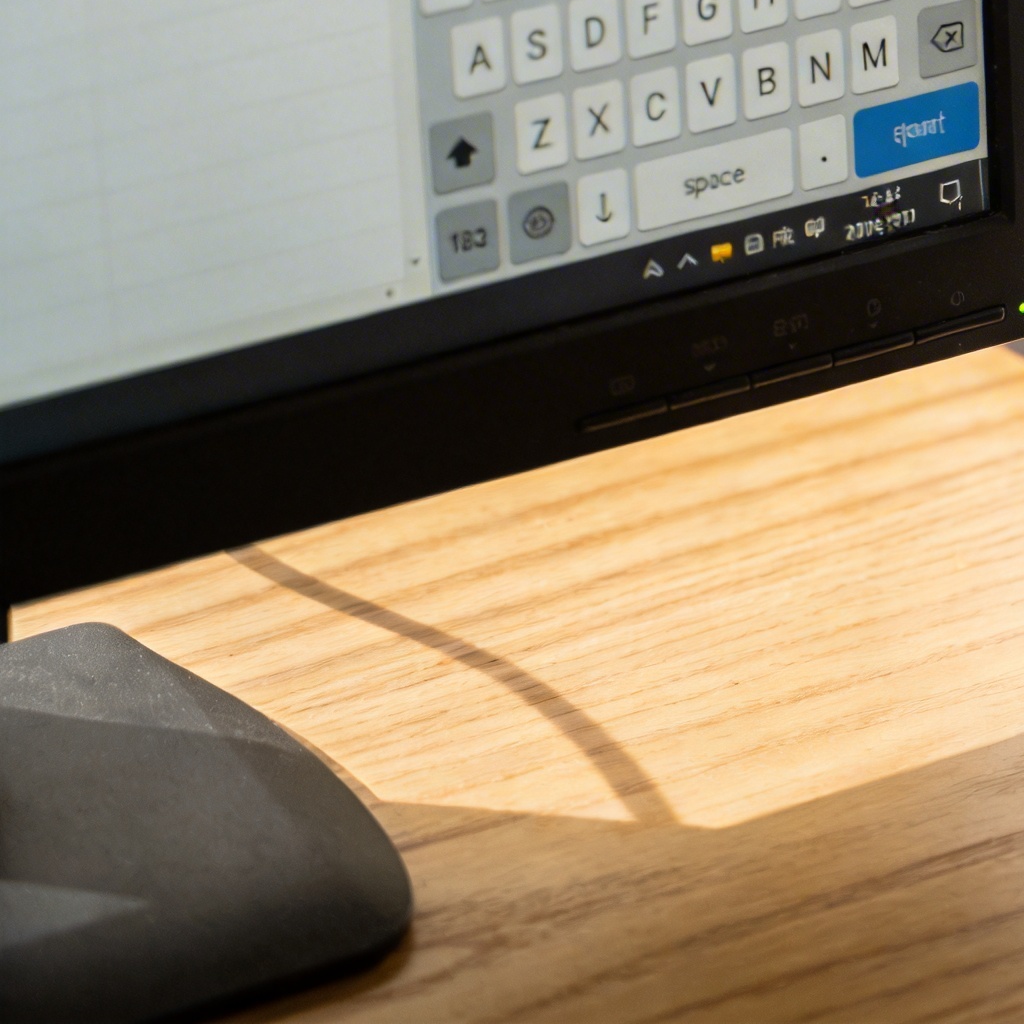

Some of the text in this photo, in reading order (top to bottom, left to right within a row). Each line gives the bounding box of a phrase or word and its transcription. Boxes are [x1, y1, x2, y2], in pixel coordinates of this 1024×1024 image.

[469, 44, 492, 74] A
[527, 28, 548, 61] S
[584, 15, 606, 50] D
[642, 2, 659, 36] F
[532, 37, 887, 150] Z X C V B N M
